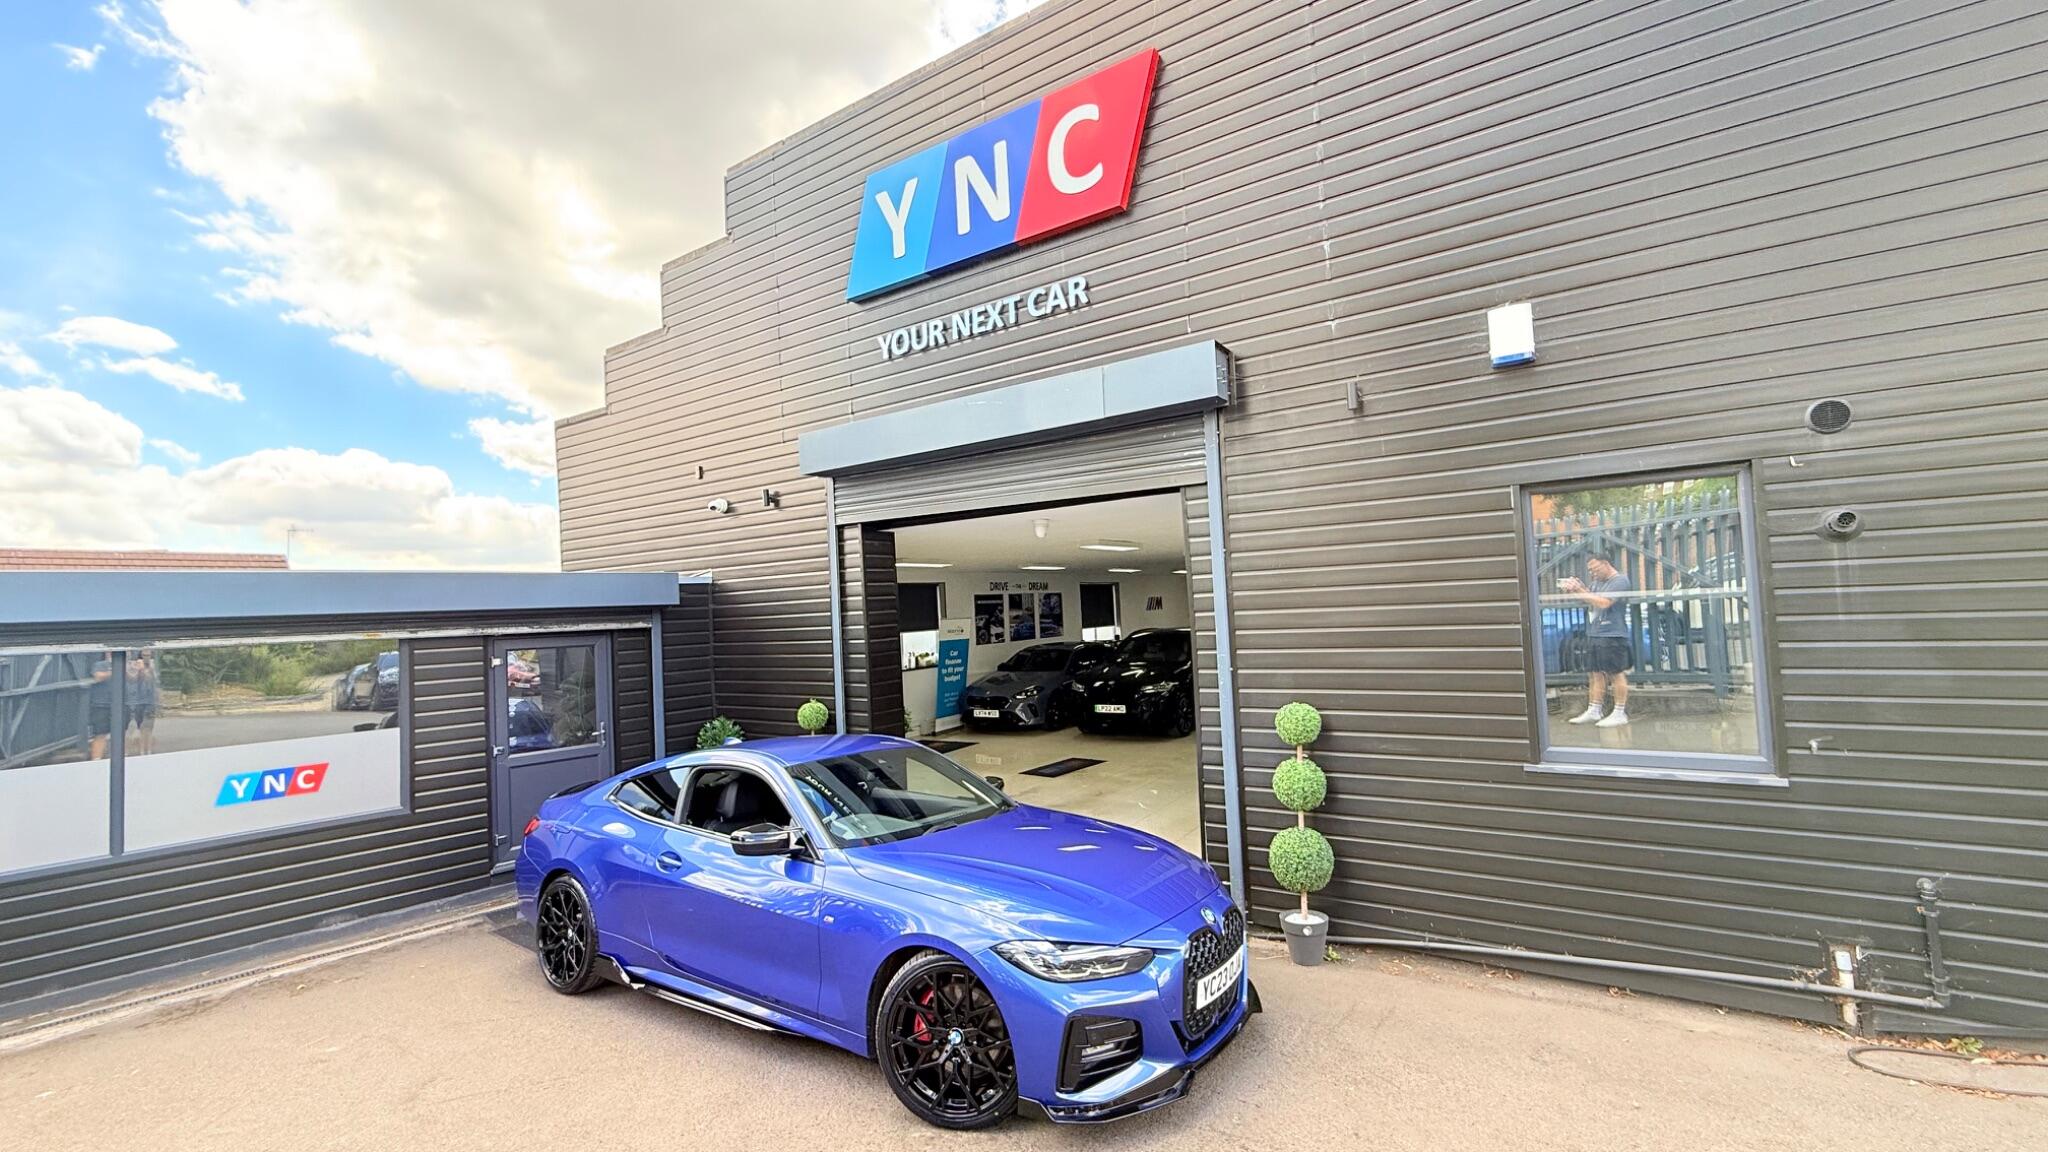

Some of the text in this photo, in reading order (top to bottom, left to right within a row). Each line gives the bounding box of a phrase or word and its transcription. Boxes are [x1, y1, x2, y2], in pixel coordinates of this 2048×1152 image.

[874, 103, 1104, 259] YNC
[877, 276, 1090, 360] YOUR NEXT CAR
[989, 581, 1009, 592] DRIVE
[1028, 581, 1049, 591] DREAM
[229, 769, 315, 799] YNC
[1203, 967, 1228, 1000] YC23
